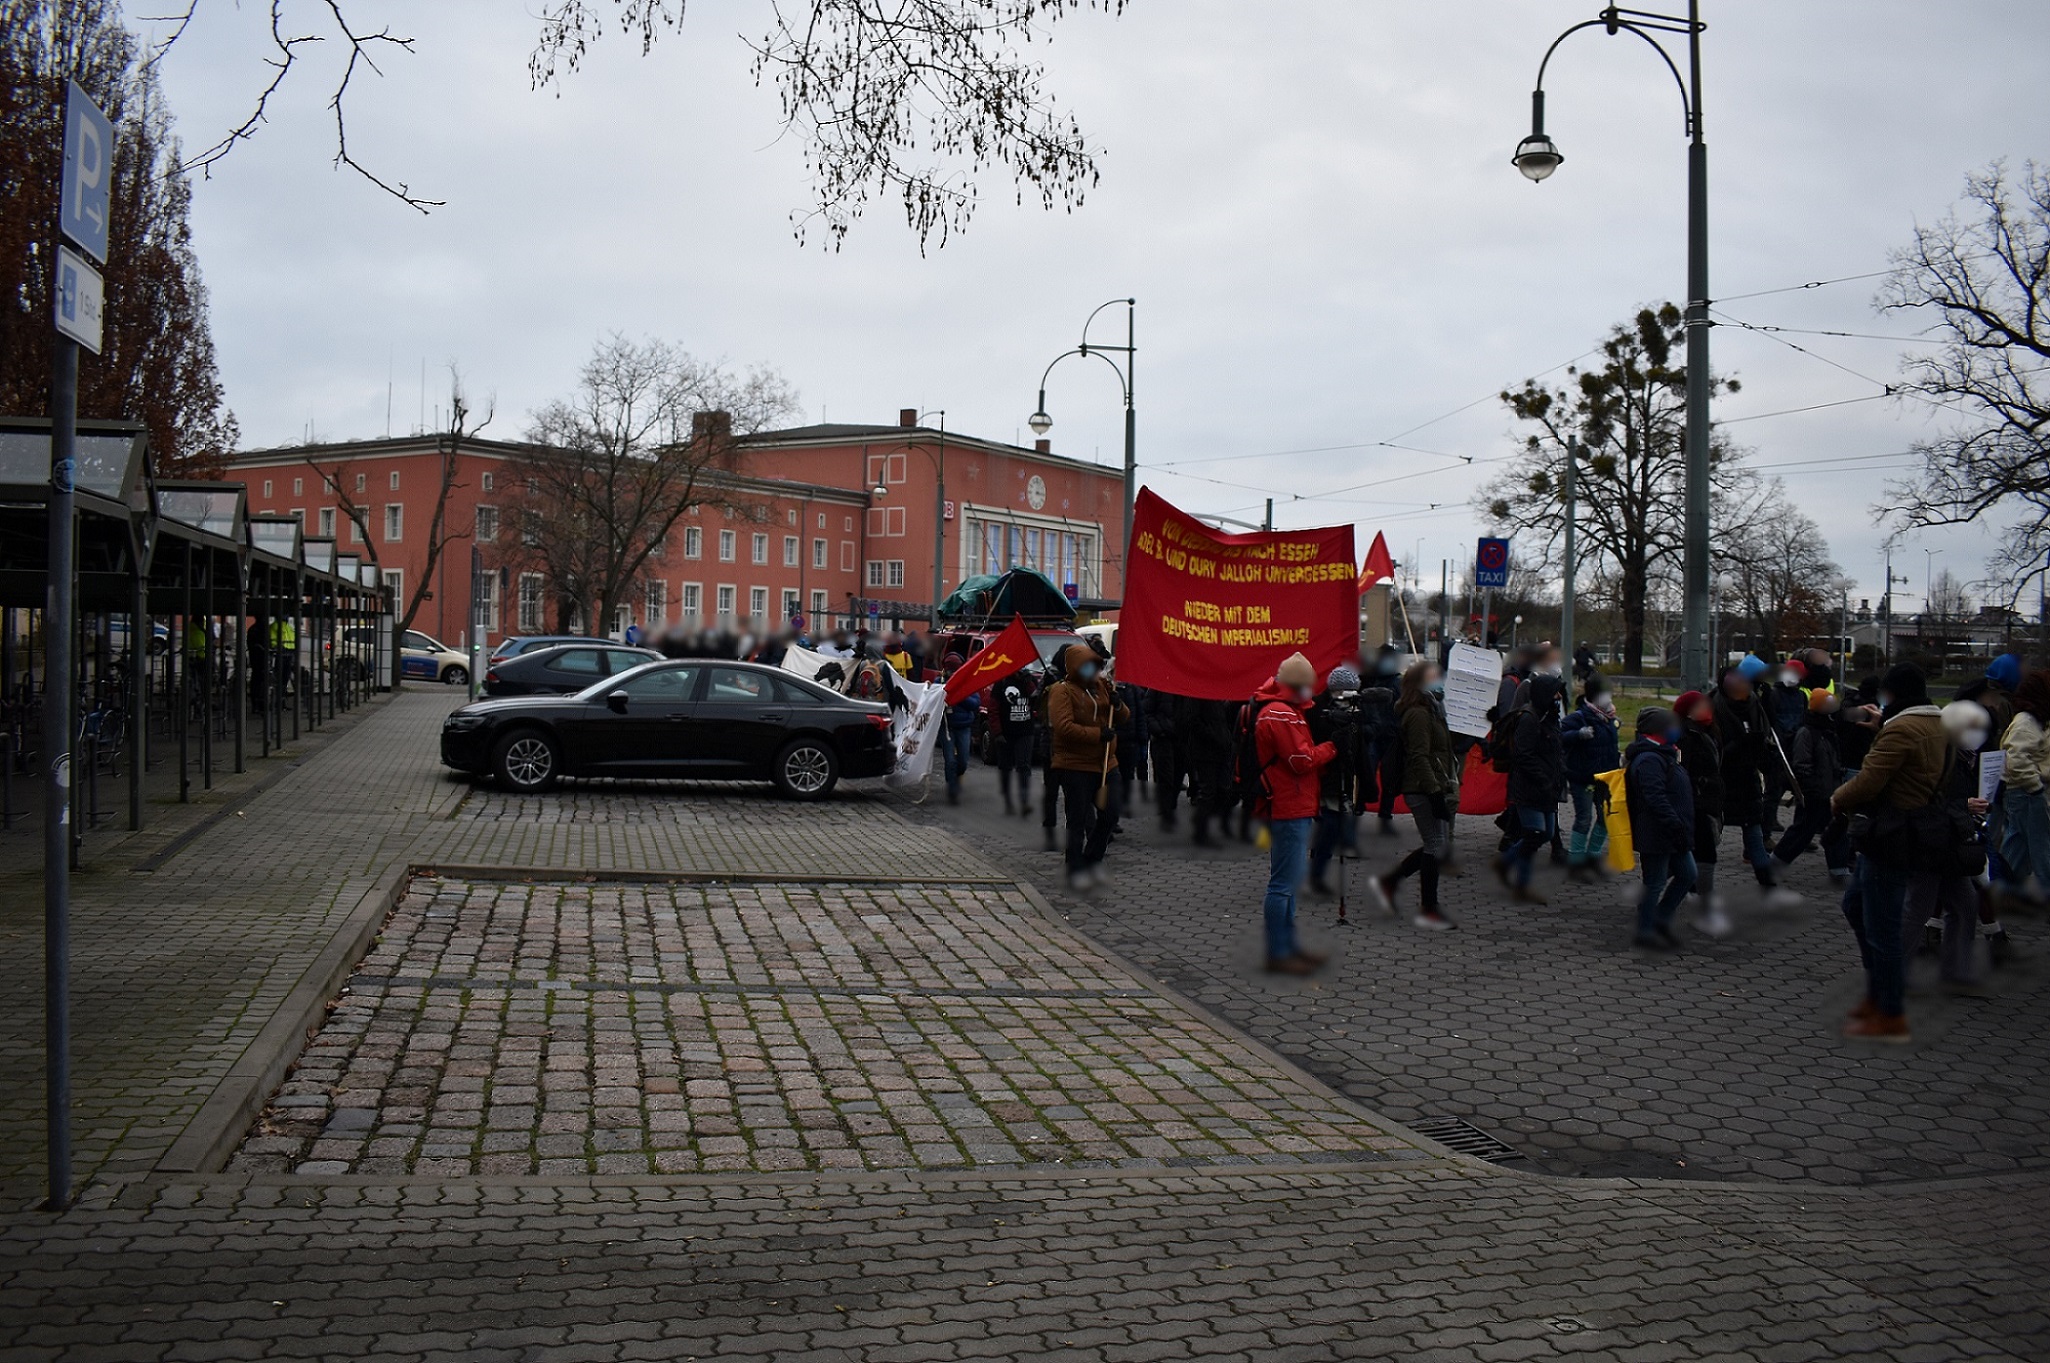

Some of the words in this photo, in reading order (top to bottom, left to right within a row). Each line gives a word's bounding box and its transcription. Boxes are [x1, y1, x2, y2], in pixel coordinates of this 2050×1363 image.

[74, 111, 101, 221] P
[1166, 546, 1187, 571] UND
[1189, 555, 1216, 579] OURY
[1219, 563, 1262, 582] JALLOH
[1265, 562, 1355, 584] UNVERGESSEN
[1279, 543, 1318, 561] ESSEN
[1478, 571, 1504, 583] TAXI
[1185, 600, 1221, 622] NIEDER
[1224, 606, 1242, 624] MIT
[1246, 605, 1271, 624] DEM
[1162, 615, 1218, 644] DEUTSCHEN
[1221, 627, 1309, 646] IMPERIALISMUS!
